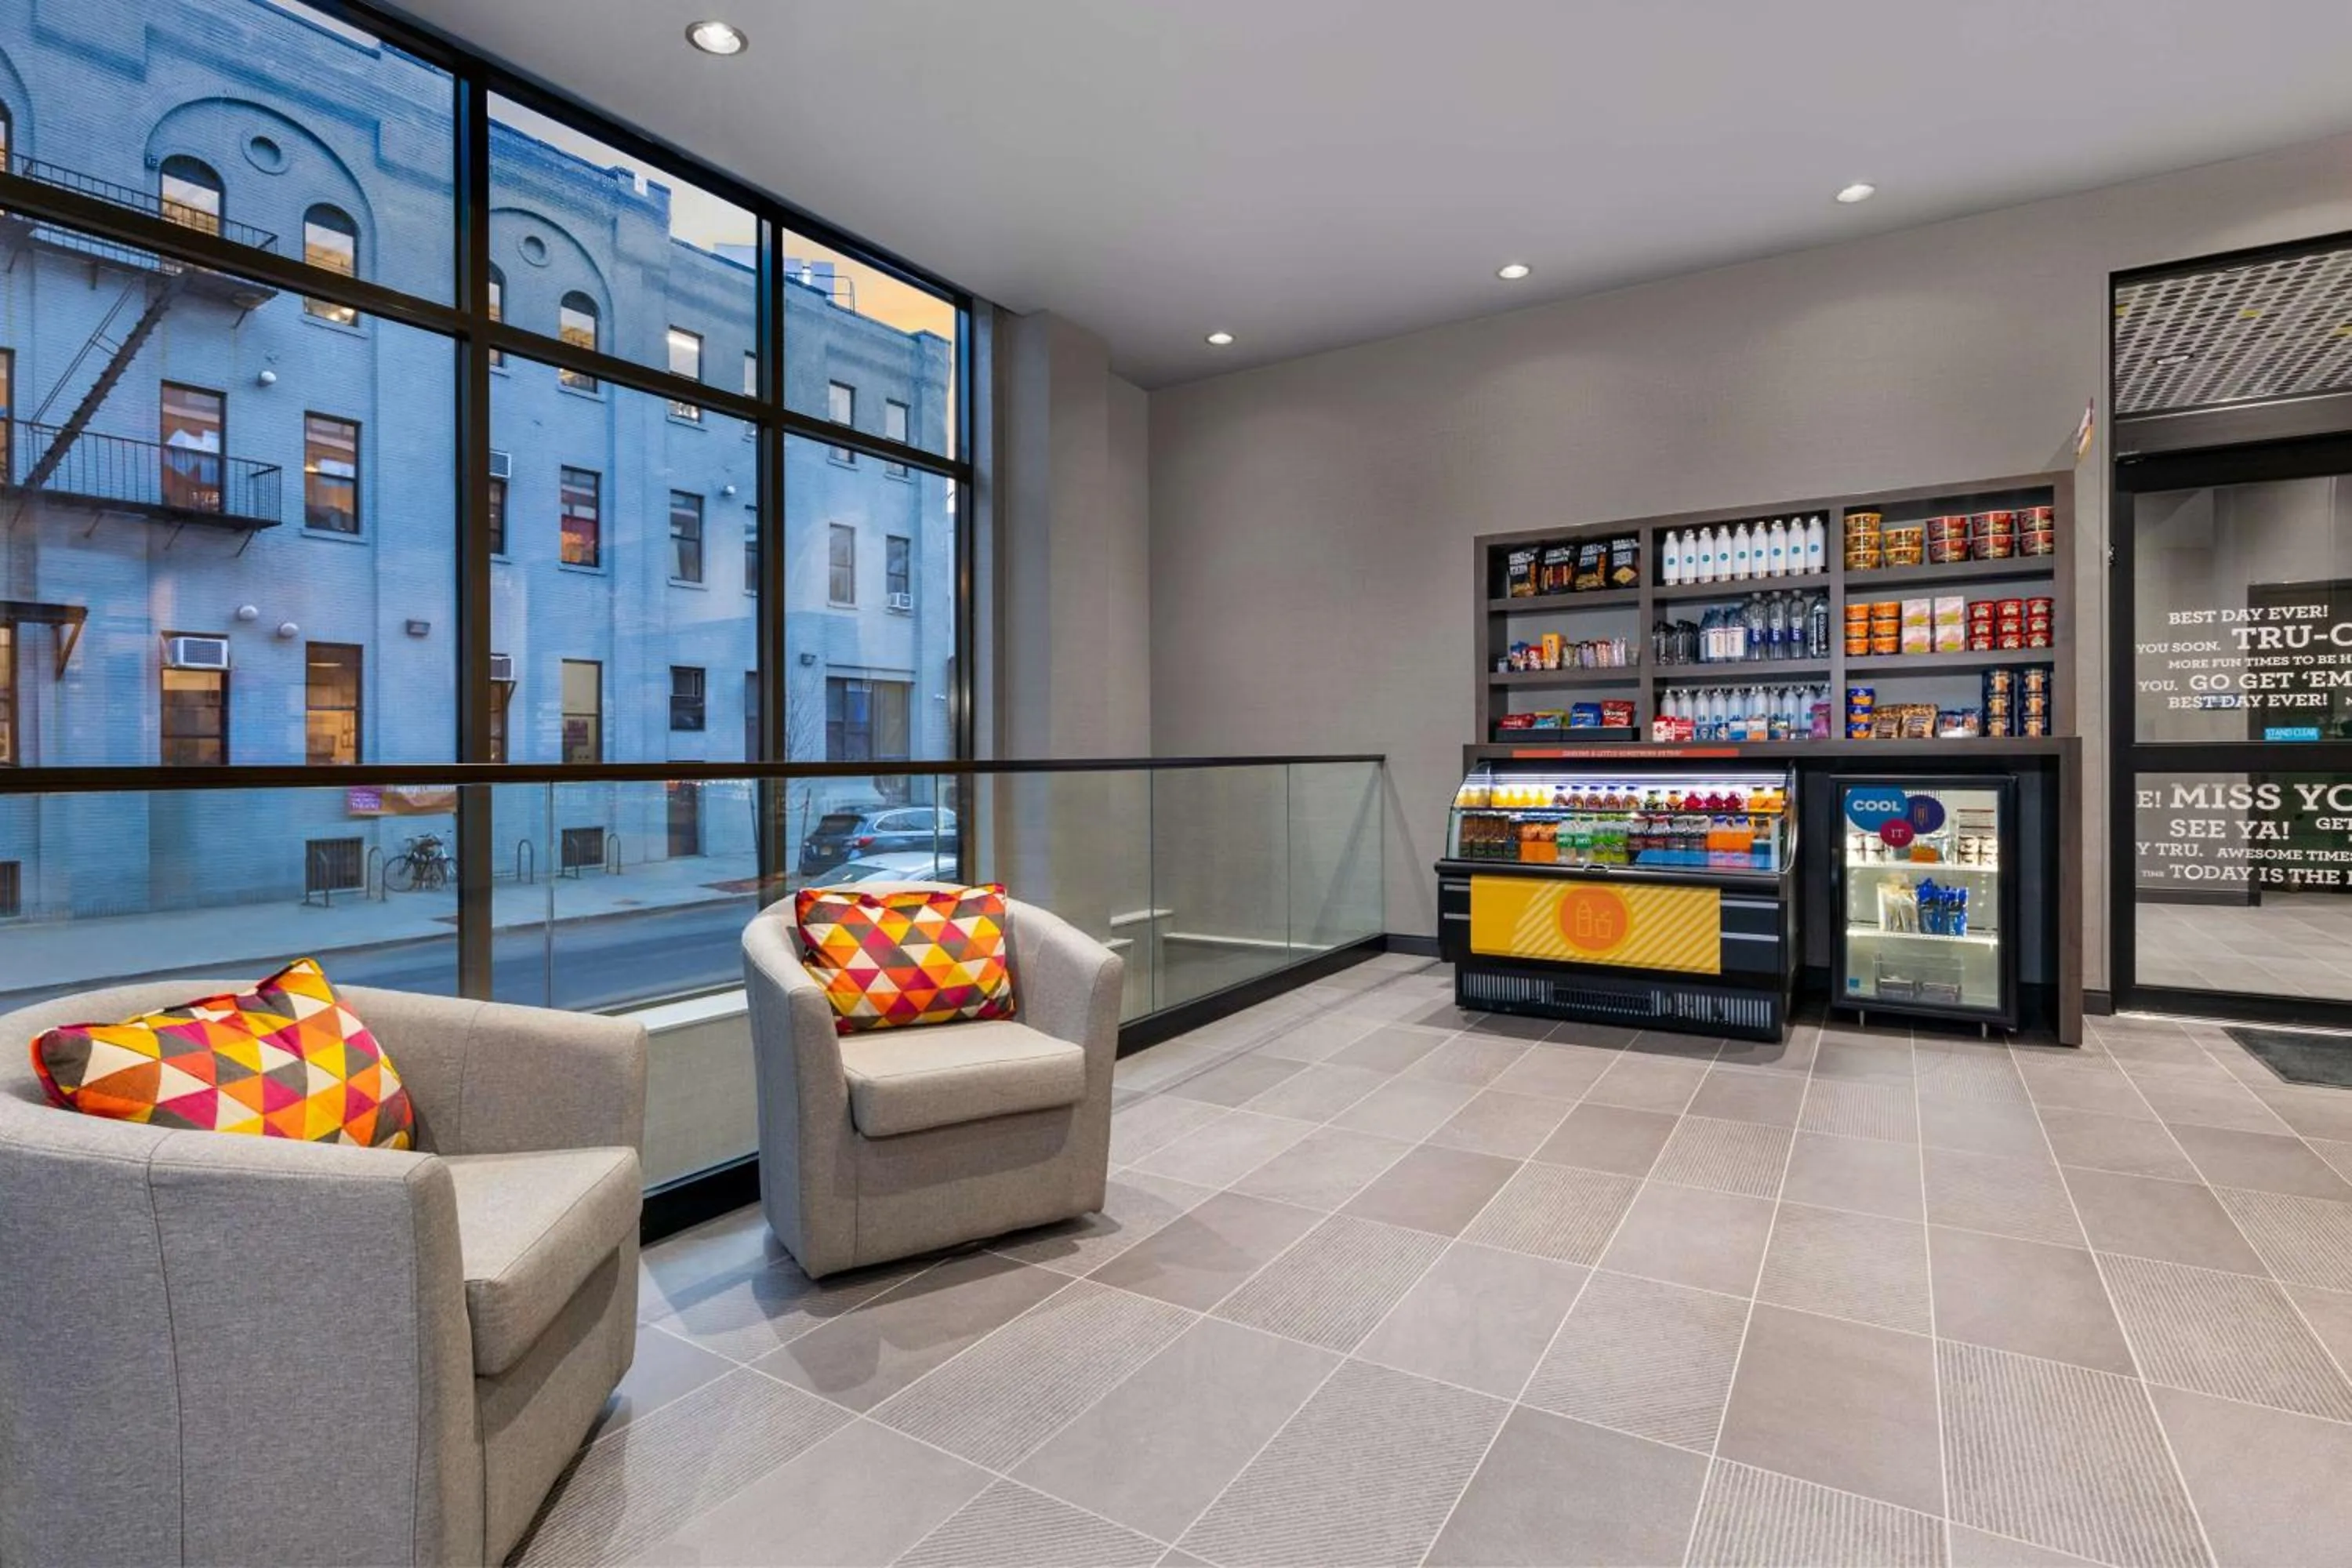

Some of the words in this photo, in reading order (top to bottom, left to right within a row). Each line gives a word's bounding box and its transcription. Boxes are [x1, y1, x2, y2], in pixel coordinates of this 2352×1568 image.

[2168, 611, 2216, 625] BEST
[2221, 608, 2263, 623] DAY
[2268, 605, 2328, 620] EVER!
[2136, 642, 2169, 655] YOU
[2171, 641, 2221, 653] SOON.
[2169, 659, 2209, 670] MORE
[2212, 657, 2241, 668] FUN
[2245, 655, 2290, 666] TIMES
[2292, 655, 2314, 666] TO
[2318, 654, 2337, 664] BE
[2138, 679, 2178, 692] YOU.
[2189, 673, 2230, 691] GO
[2238, 672, 2295, 689] GET
[2168, 695, 2215, 710] BEST
[2220, 694, 2263, 708] DAY
[2267, 692, 2328, 706] EVER!
[2169, 782, 2282, 810] MISS
[1853, 800, 1902, 812] COOL
[1890, 828, 1904, 838] IT
[2169, 819, 2227, 838] SEE
[2235, 821, 2290, 840] YA!
[2154, 843, 2204, 857] TRU.
[2217, 848, 2303, 860] AWESOME
[2169, 863, 2254, 880] TODAY
[2259, 866, 2284, 884] IS
[2288, 869, 2340, 885] THE
